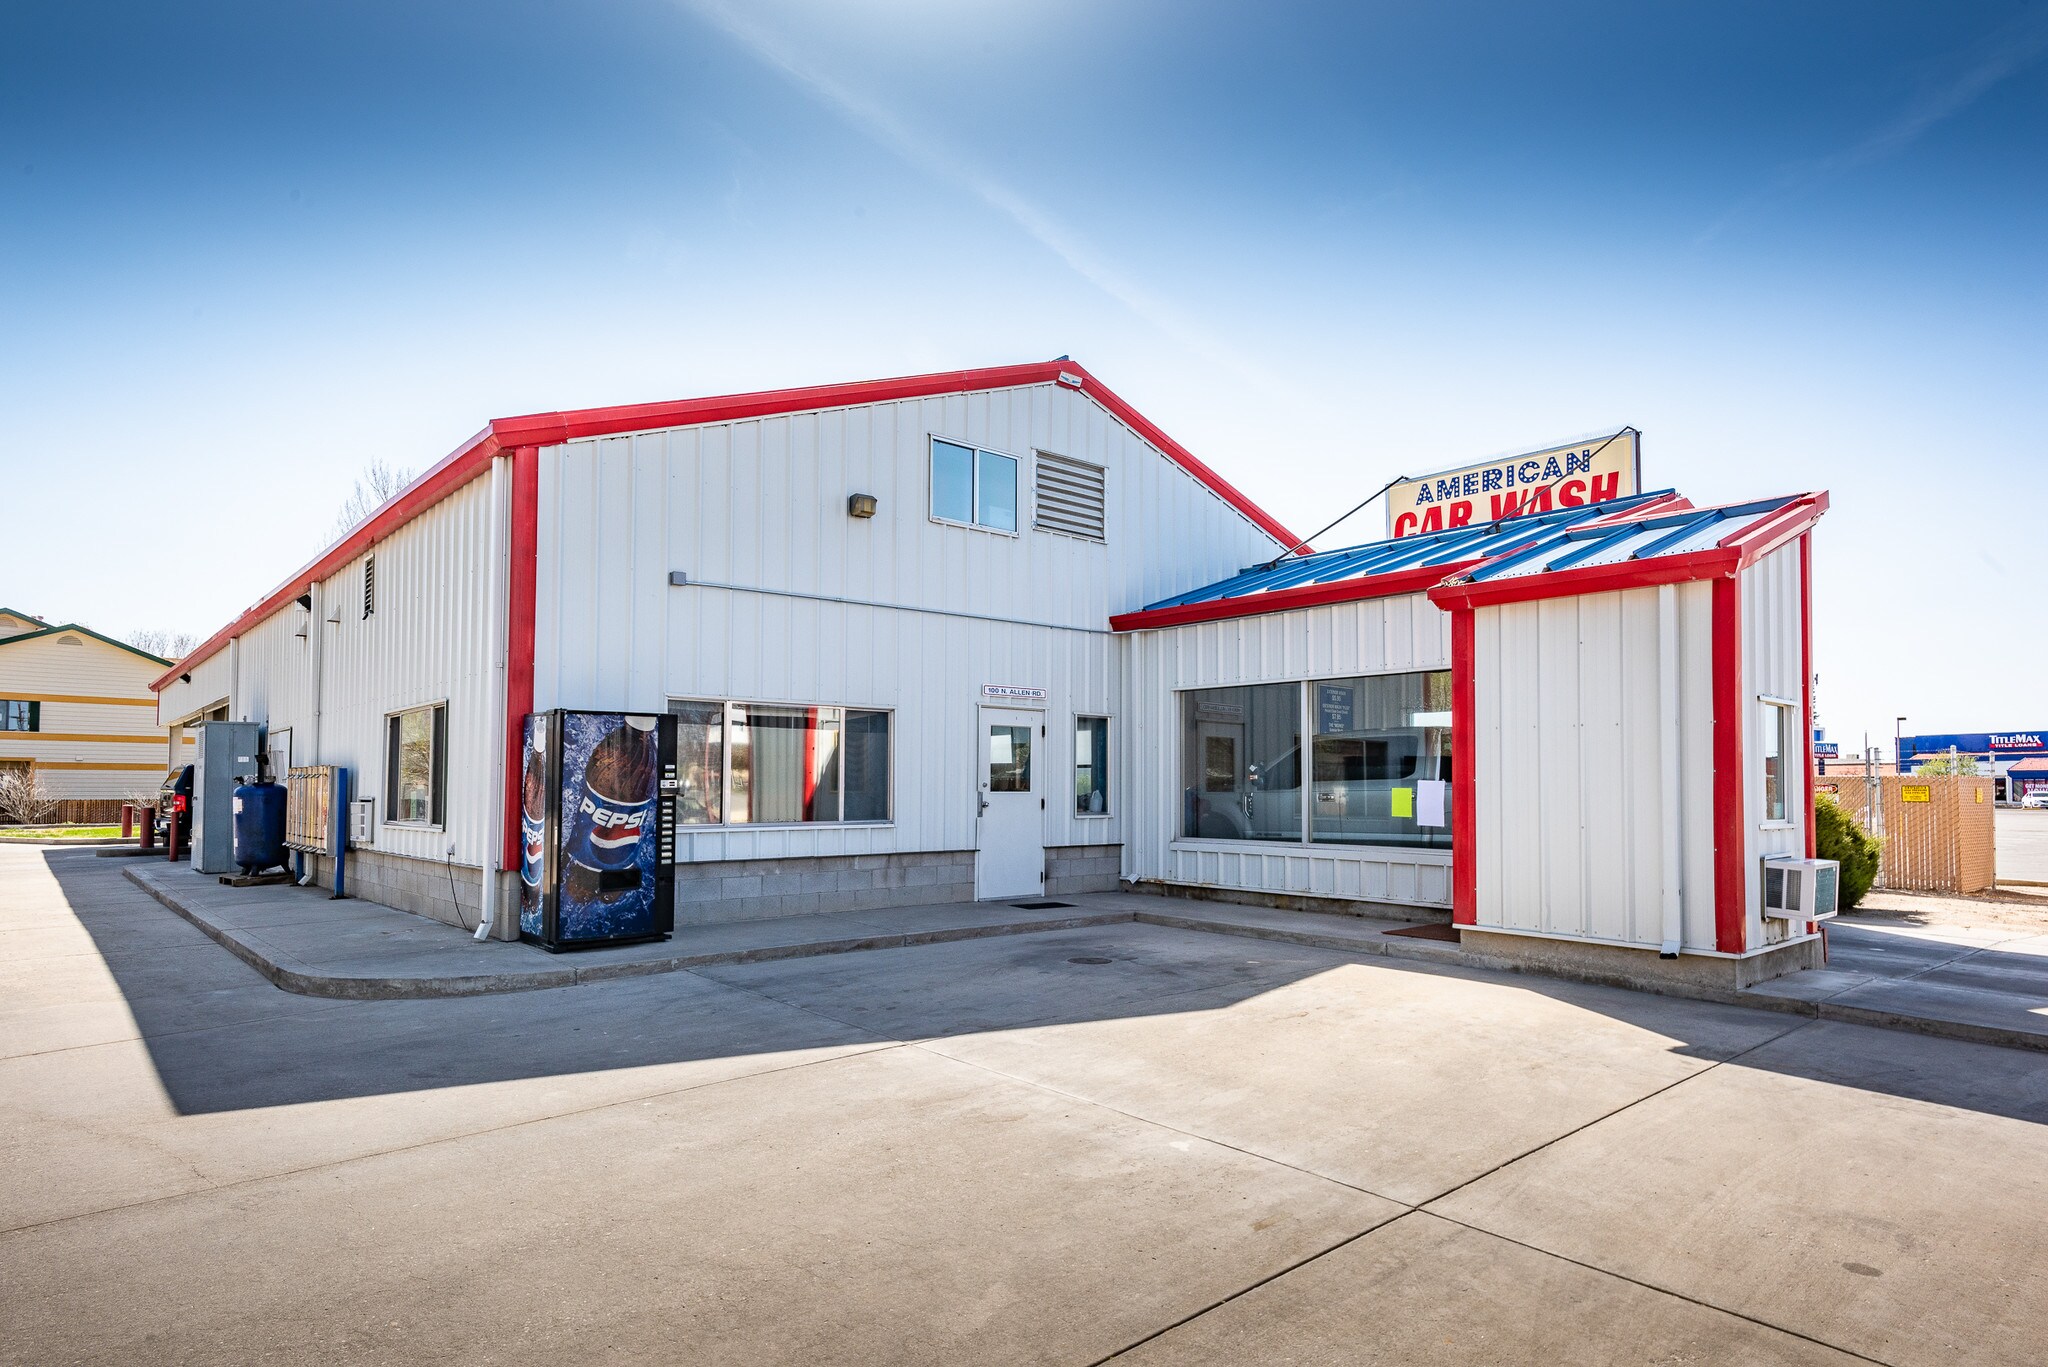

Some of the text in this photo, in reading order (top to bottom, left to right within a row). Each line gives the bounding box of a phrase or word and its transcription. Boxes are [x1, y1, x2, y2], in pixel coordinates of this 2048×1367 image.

[1394, 471, 1620, 539] CAR WASH
[1416, 449, 1590, 506] AMERICAN
[579, 796, 648, 830] PEPSI
